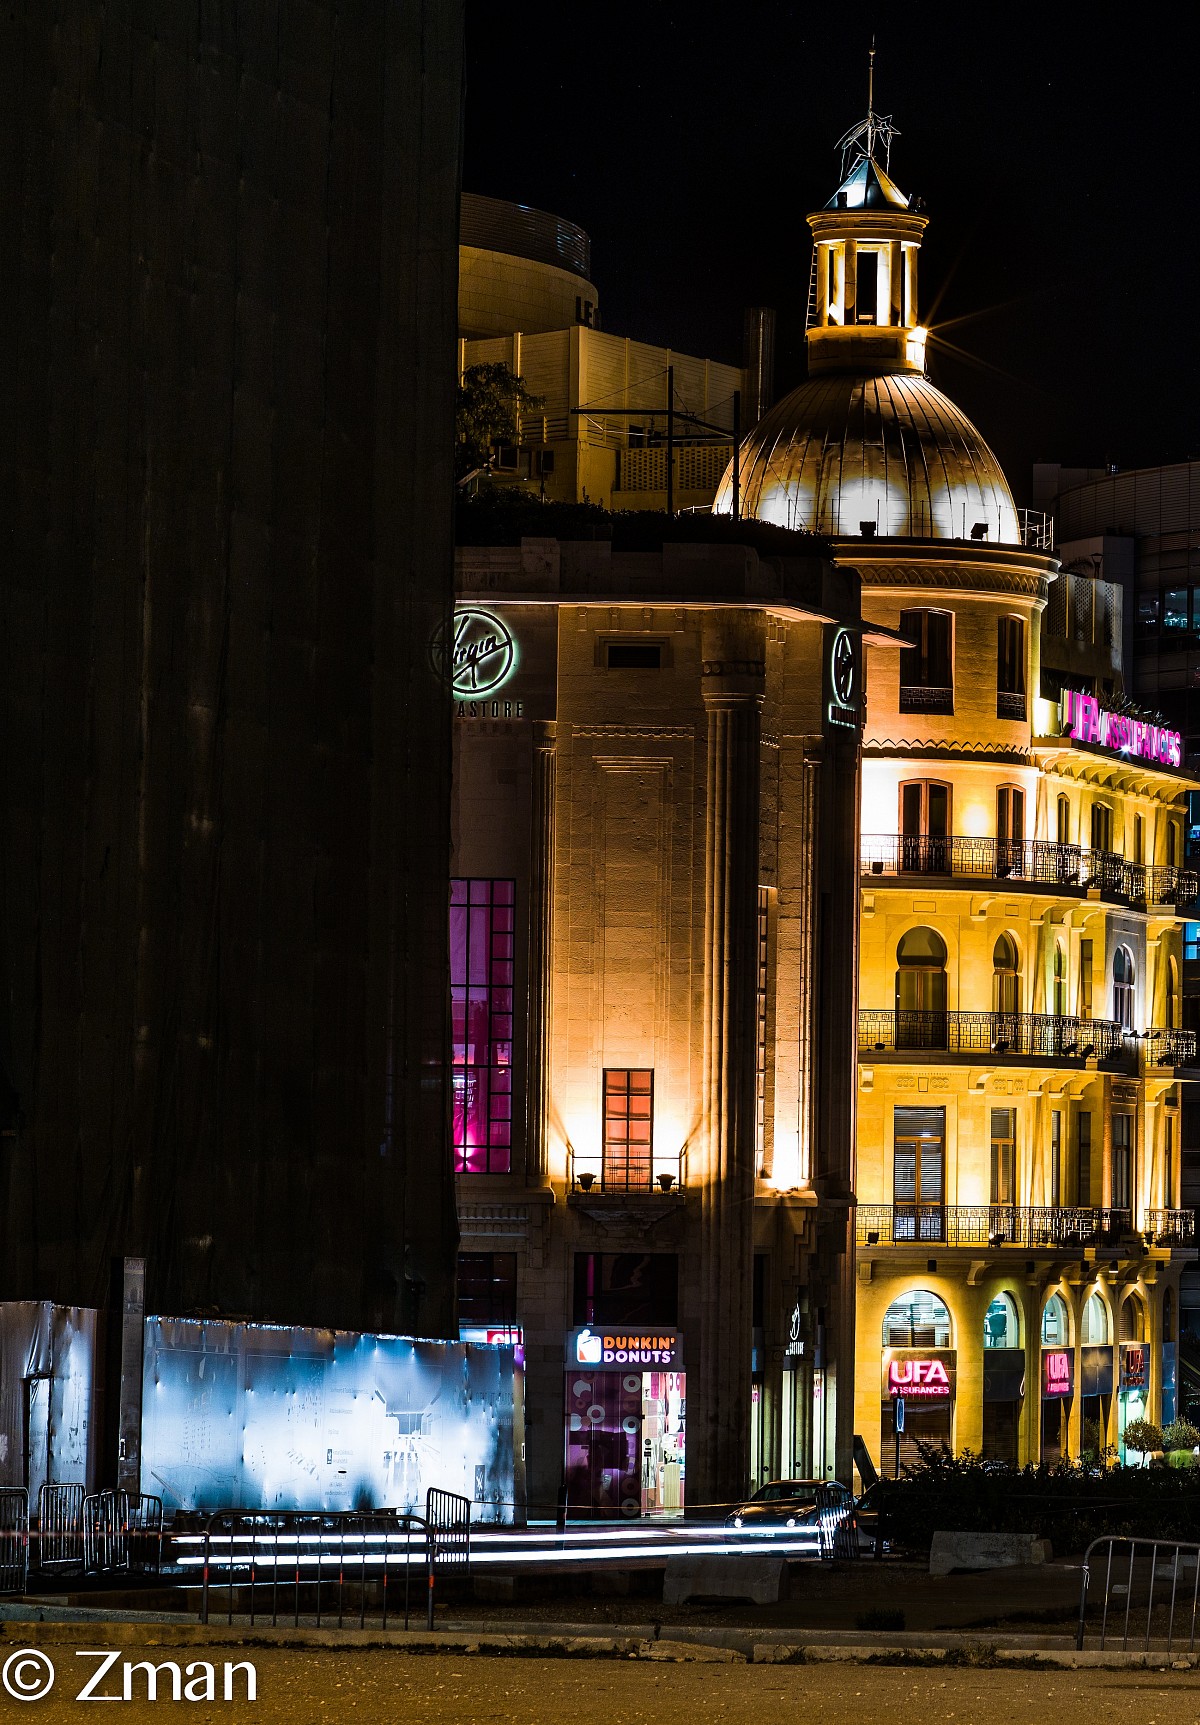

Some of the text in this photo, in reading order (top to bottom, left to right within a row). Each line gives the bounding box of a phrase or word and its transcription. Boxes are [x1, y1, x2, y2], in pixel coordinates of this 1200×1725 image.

[455, 700, 524, 719] ASTORE
[1101, 711, 1182, 768] ASSURANCES
[603, 1336, 676, 1350] DUNKIN'
[603, 1350, 671, 1364] DONUTS
[1047, 1353, 1070, 1379] UFA
[889, 1360, 950, 1383] UFA
